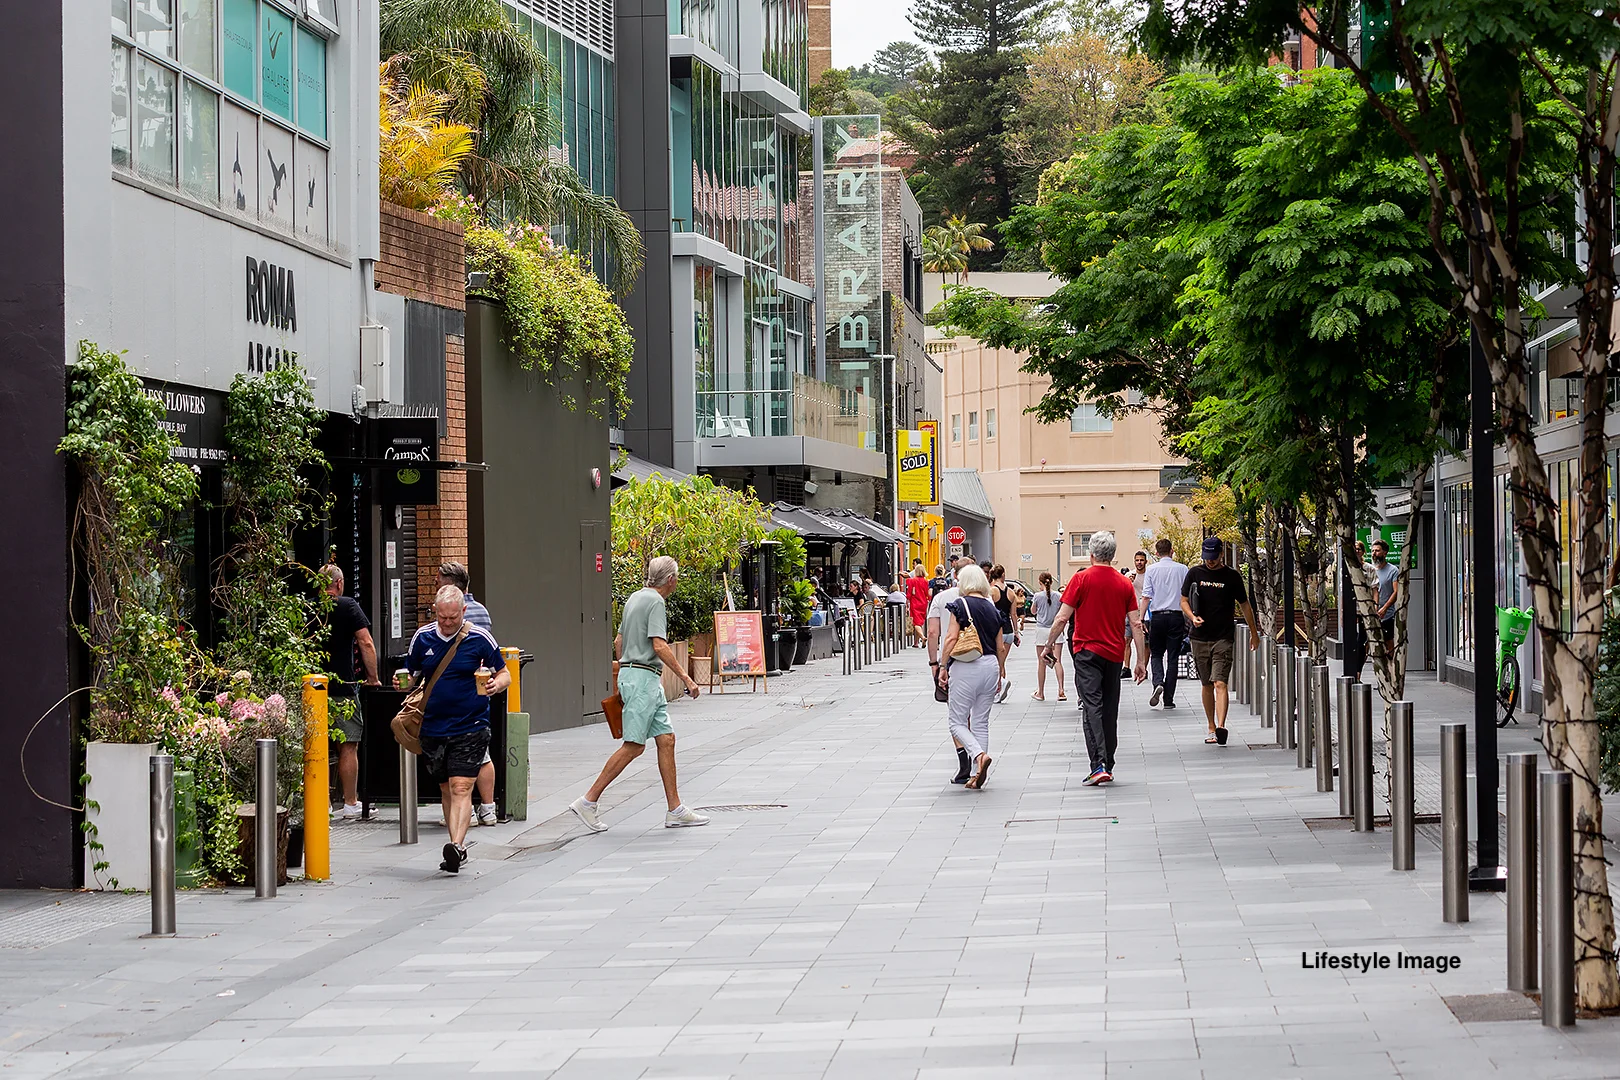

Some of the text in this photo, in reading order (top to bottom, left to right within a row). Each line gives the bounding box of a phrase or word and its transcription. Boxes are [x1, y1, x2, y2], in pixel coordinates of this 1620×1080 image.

[246, 256, 297, 333] ROMA
[166, 392, 206, 414] FLOWERS
[177, 422, 187, 433] BAY
[902, 455, 927, 470] SOLD
[948, 532, 965, 540] STOP
